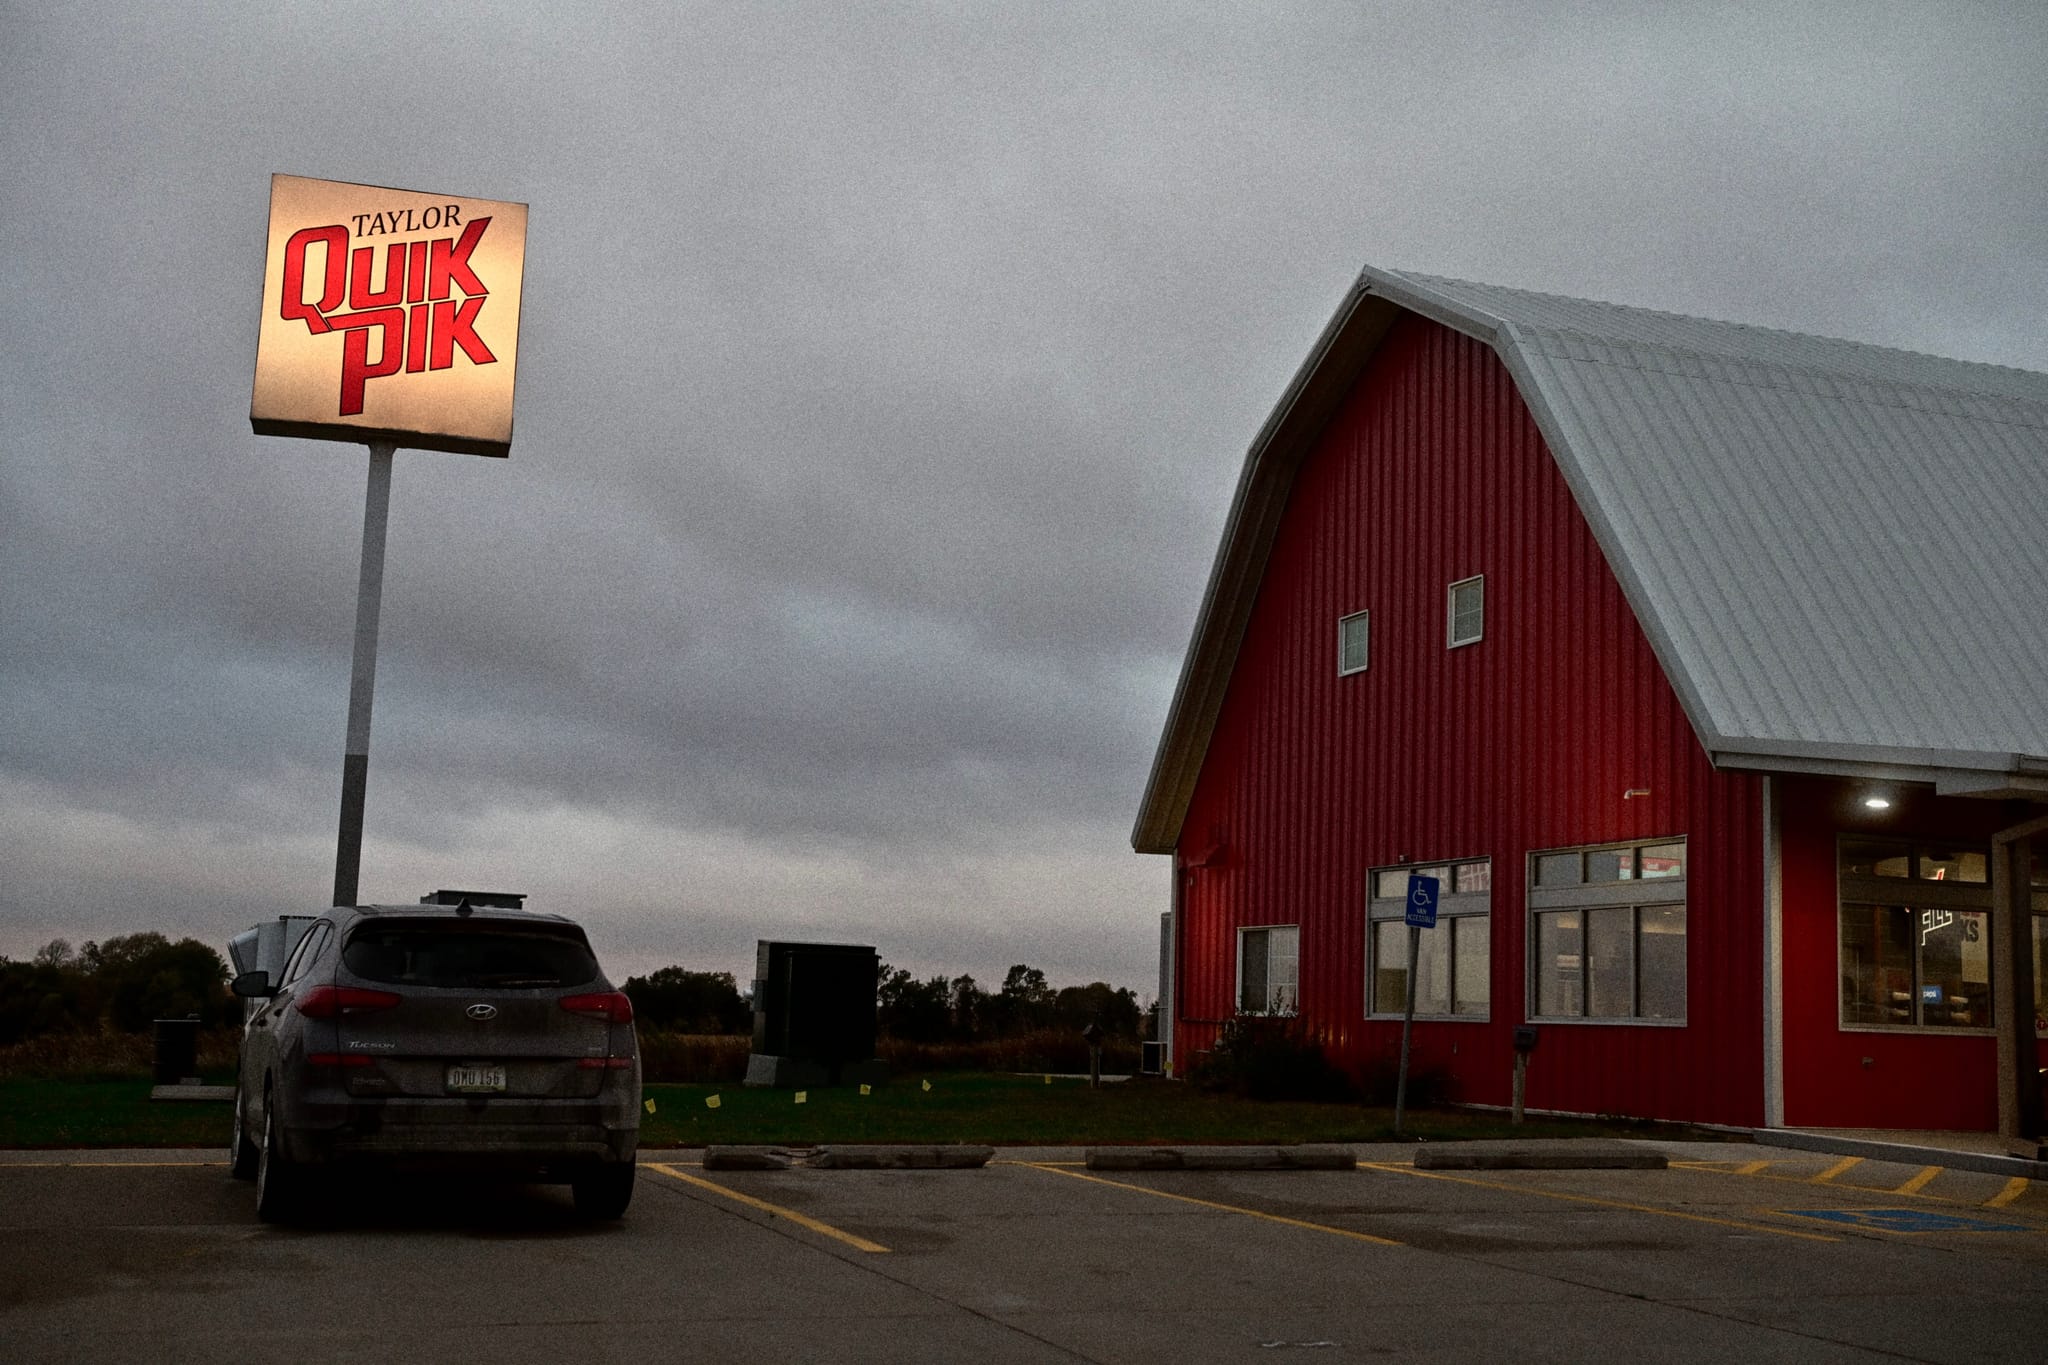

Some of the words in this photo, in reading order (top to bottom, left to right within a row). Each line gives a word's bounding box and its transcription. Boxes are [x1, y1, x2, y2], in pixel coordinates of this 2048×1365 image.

[352, 204, 462, 238] TAYLOR
[280, 215, 493, 335] QUIK
[324, 296, 498, 416] PIK
[1407, 913, 1436, 924] ACCESSIBLE
[350, 1041, 396, 1049] TUCSON
